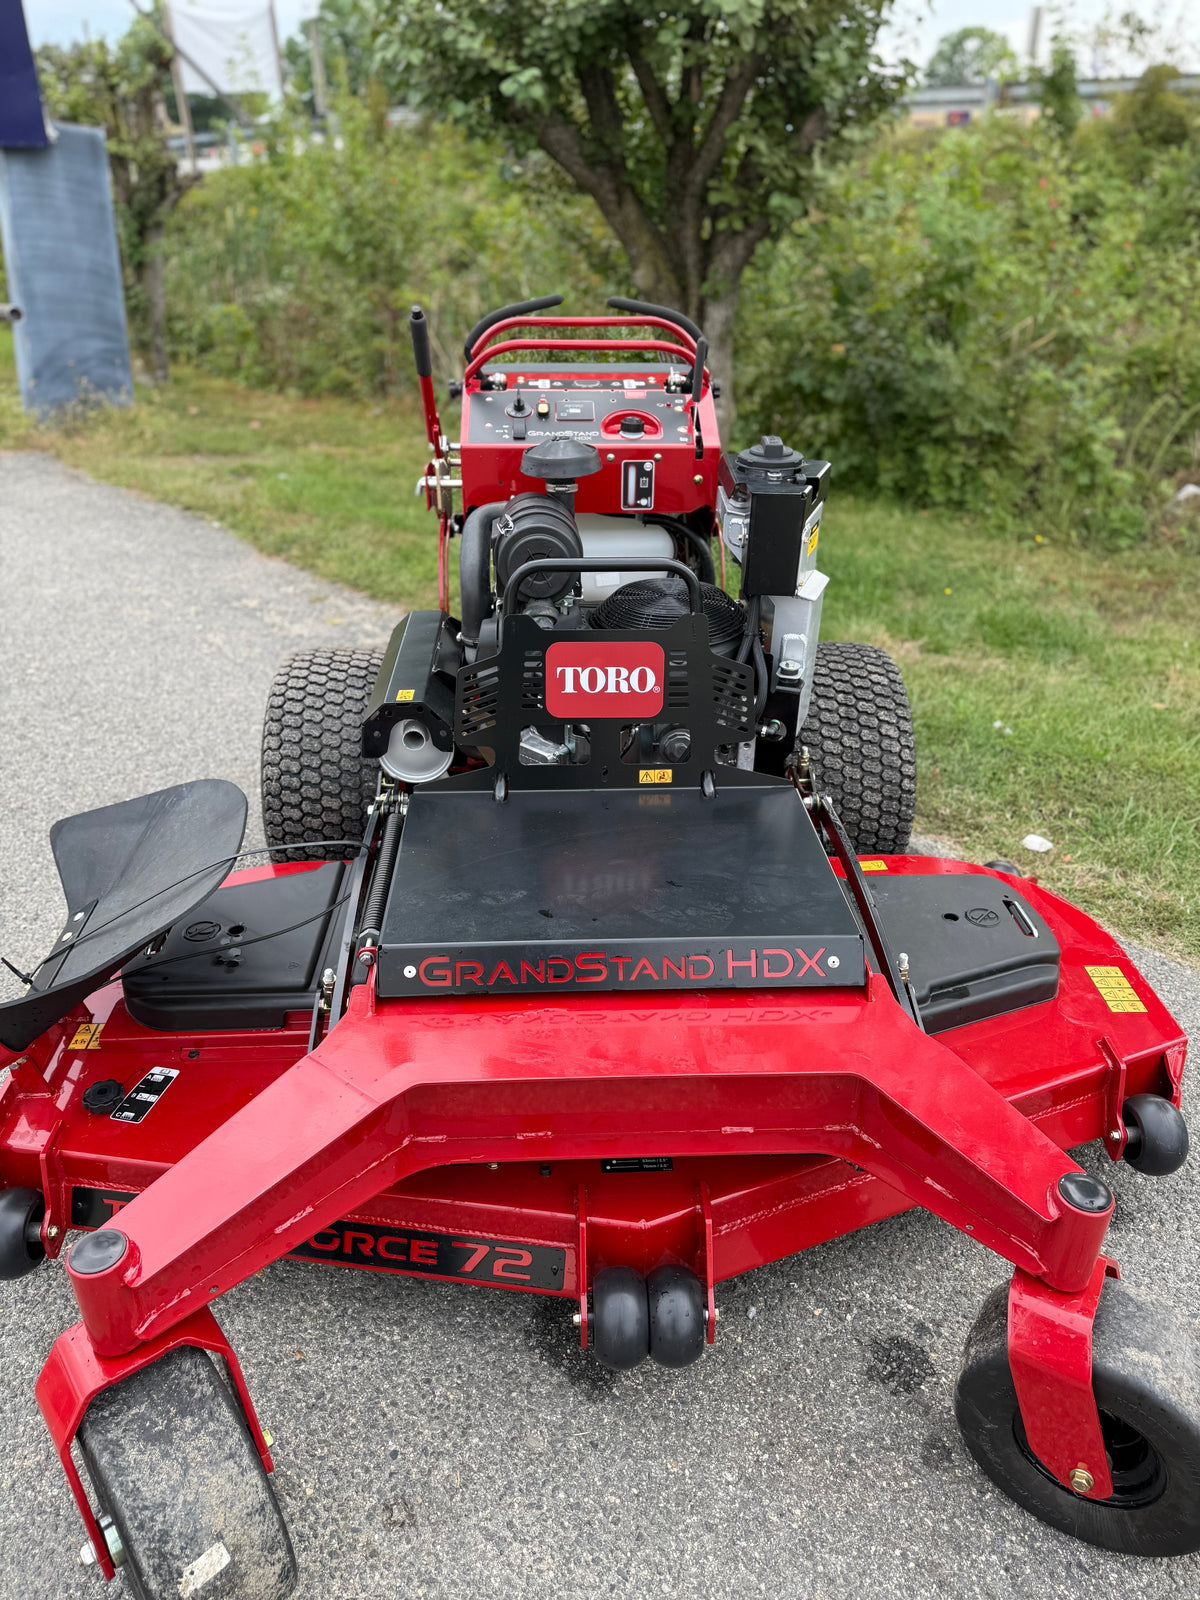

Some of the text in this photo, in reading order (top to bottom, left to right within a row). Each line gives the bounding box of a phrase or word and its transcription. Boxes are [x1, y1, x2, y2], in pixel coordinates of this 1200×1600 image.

[726, 947, 827, 979] HDX
[307, 1228, 533, 1281] ORCE 72
